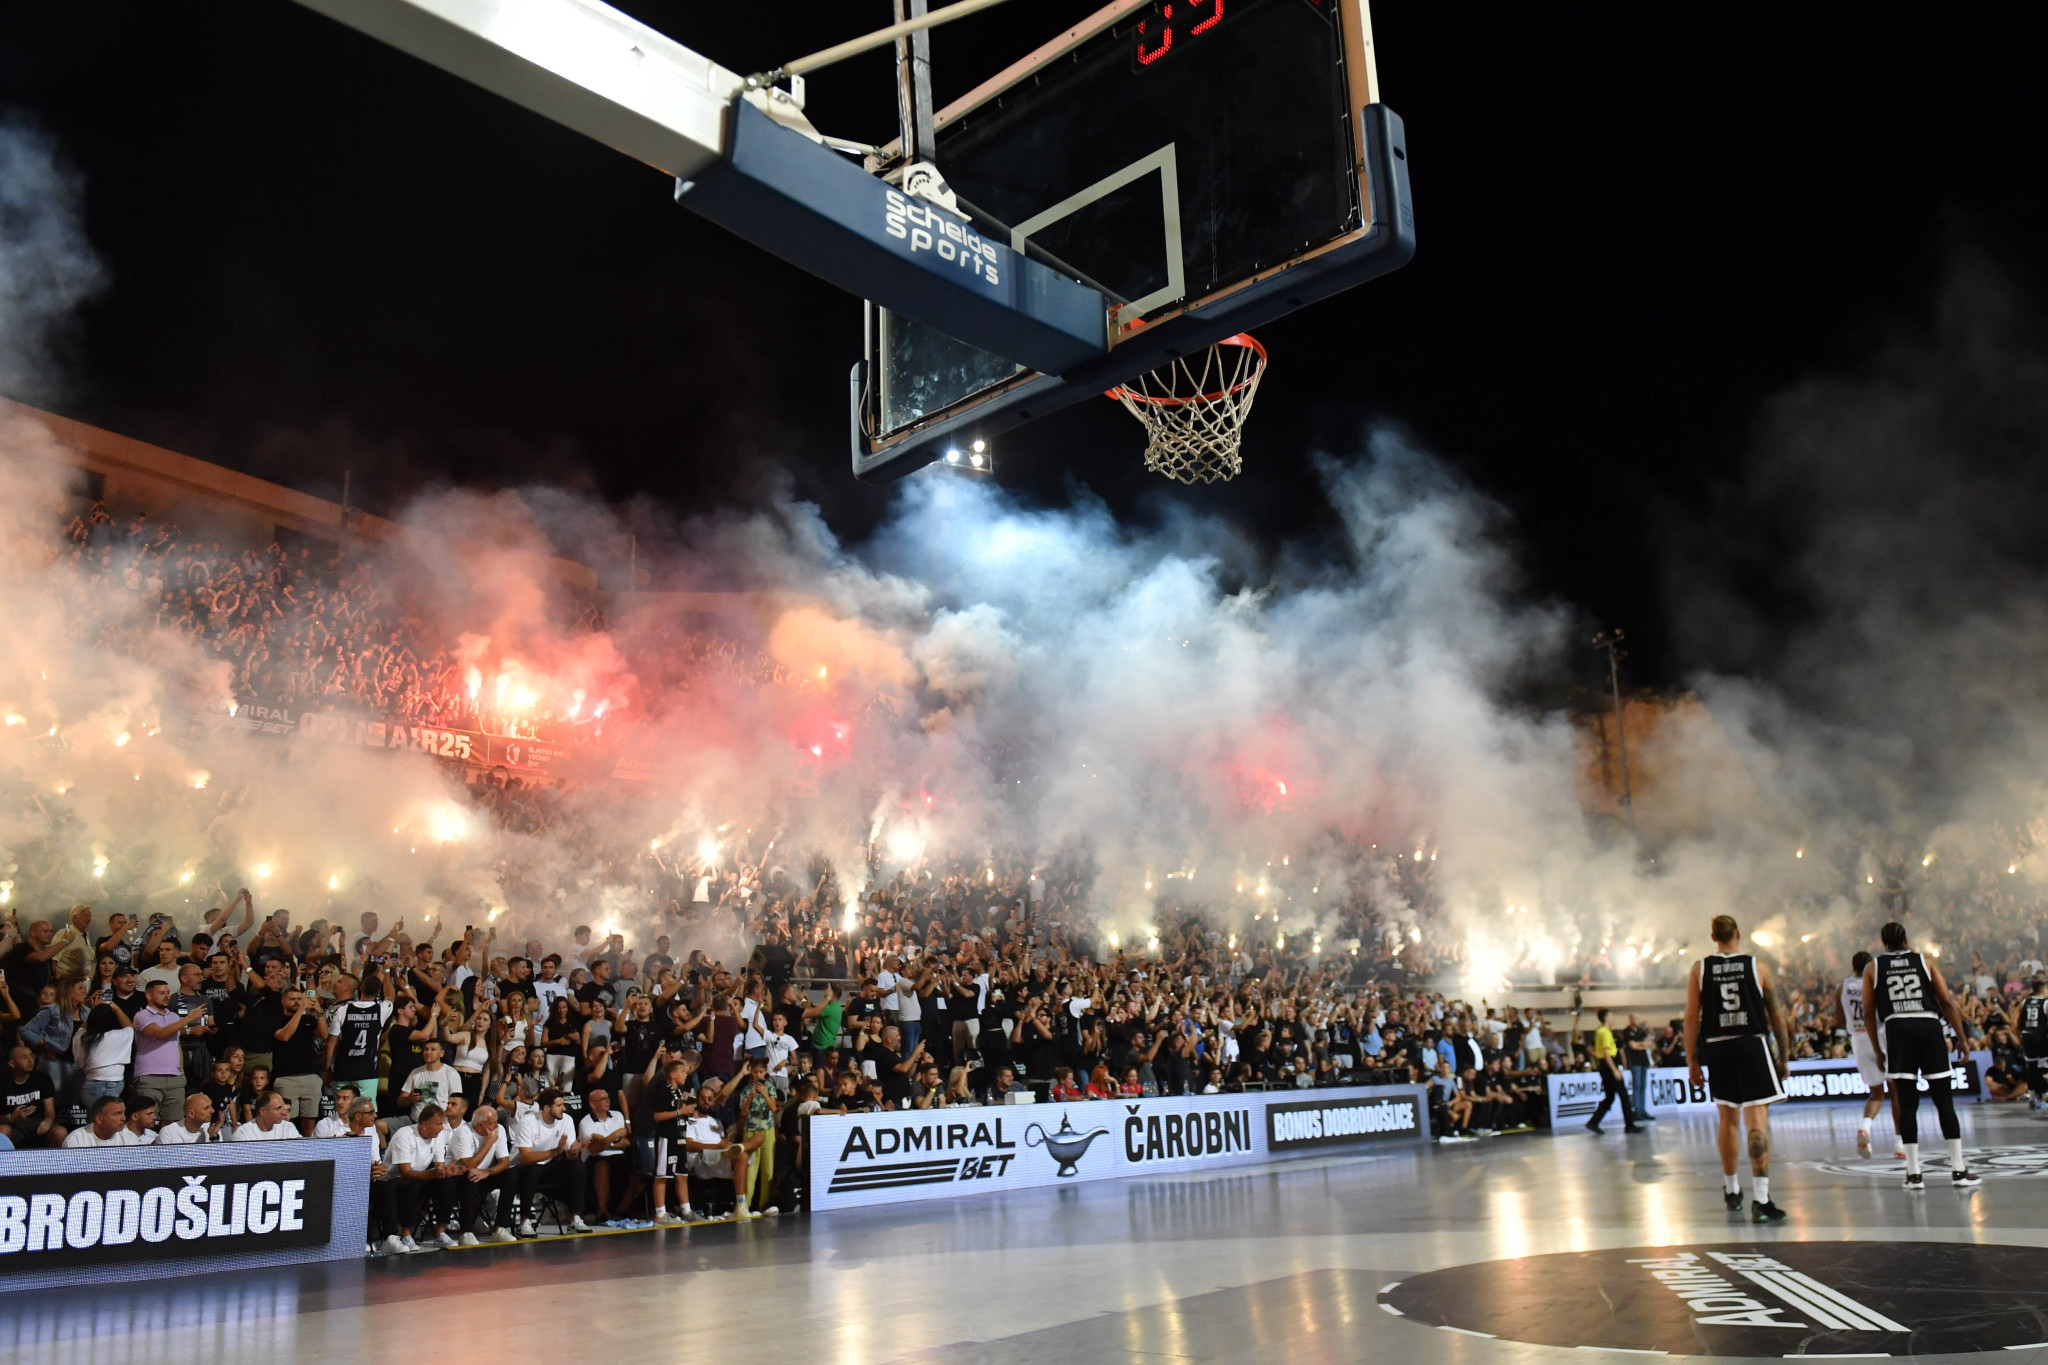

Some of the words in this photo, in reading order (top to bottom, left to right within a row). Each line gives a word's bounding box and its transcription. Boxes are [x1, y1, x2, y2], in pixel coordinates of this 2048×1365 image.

[886, 190, 997, 264] Schelde
[1720, 982, 1740, 1011] 5
[1886, 974, 1923, 1001] 22
[354, 1029, 368, 1049] 4
[839, 1117, 1016, 1162] ADMIRAL
[1125, 1104, 1251, 1162] ČAROBNI
[1273, 1109, 1322, 1142] BONUS
[1322, 1100, 1416, 1139] DOBRODOŠLICE
[959, 1153, 1016, 1181] BET
[1625, 1252, 1808, 1328] ADMIRAL
